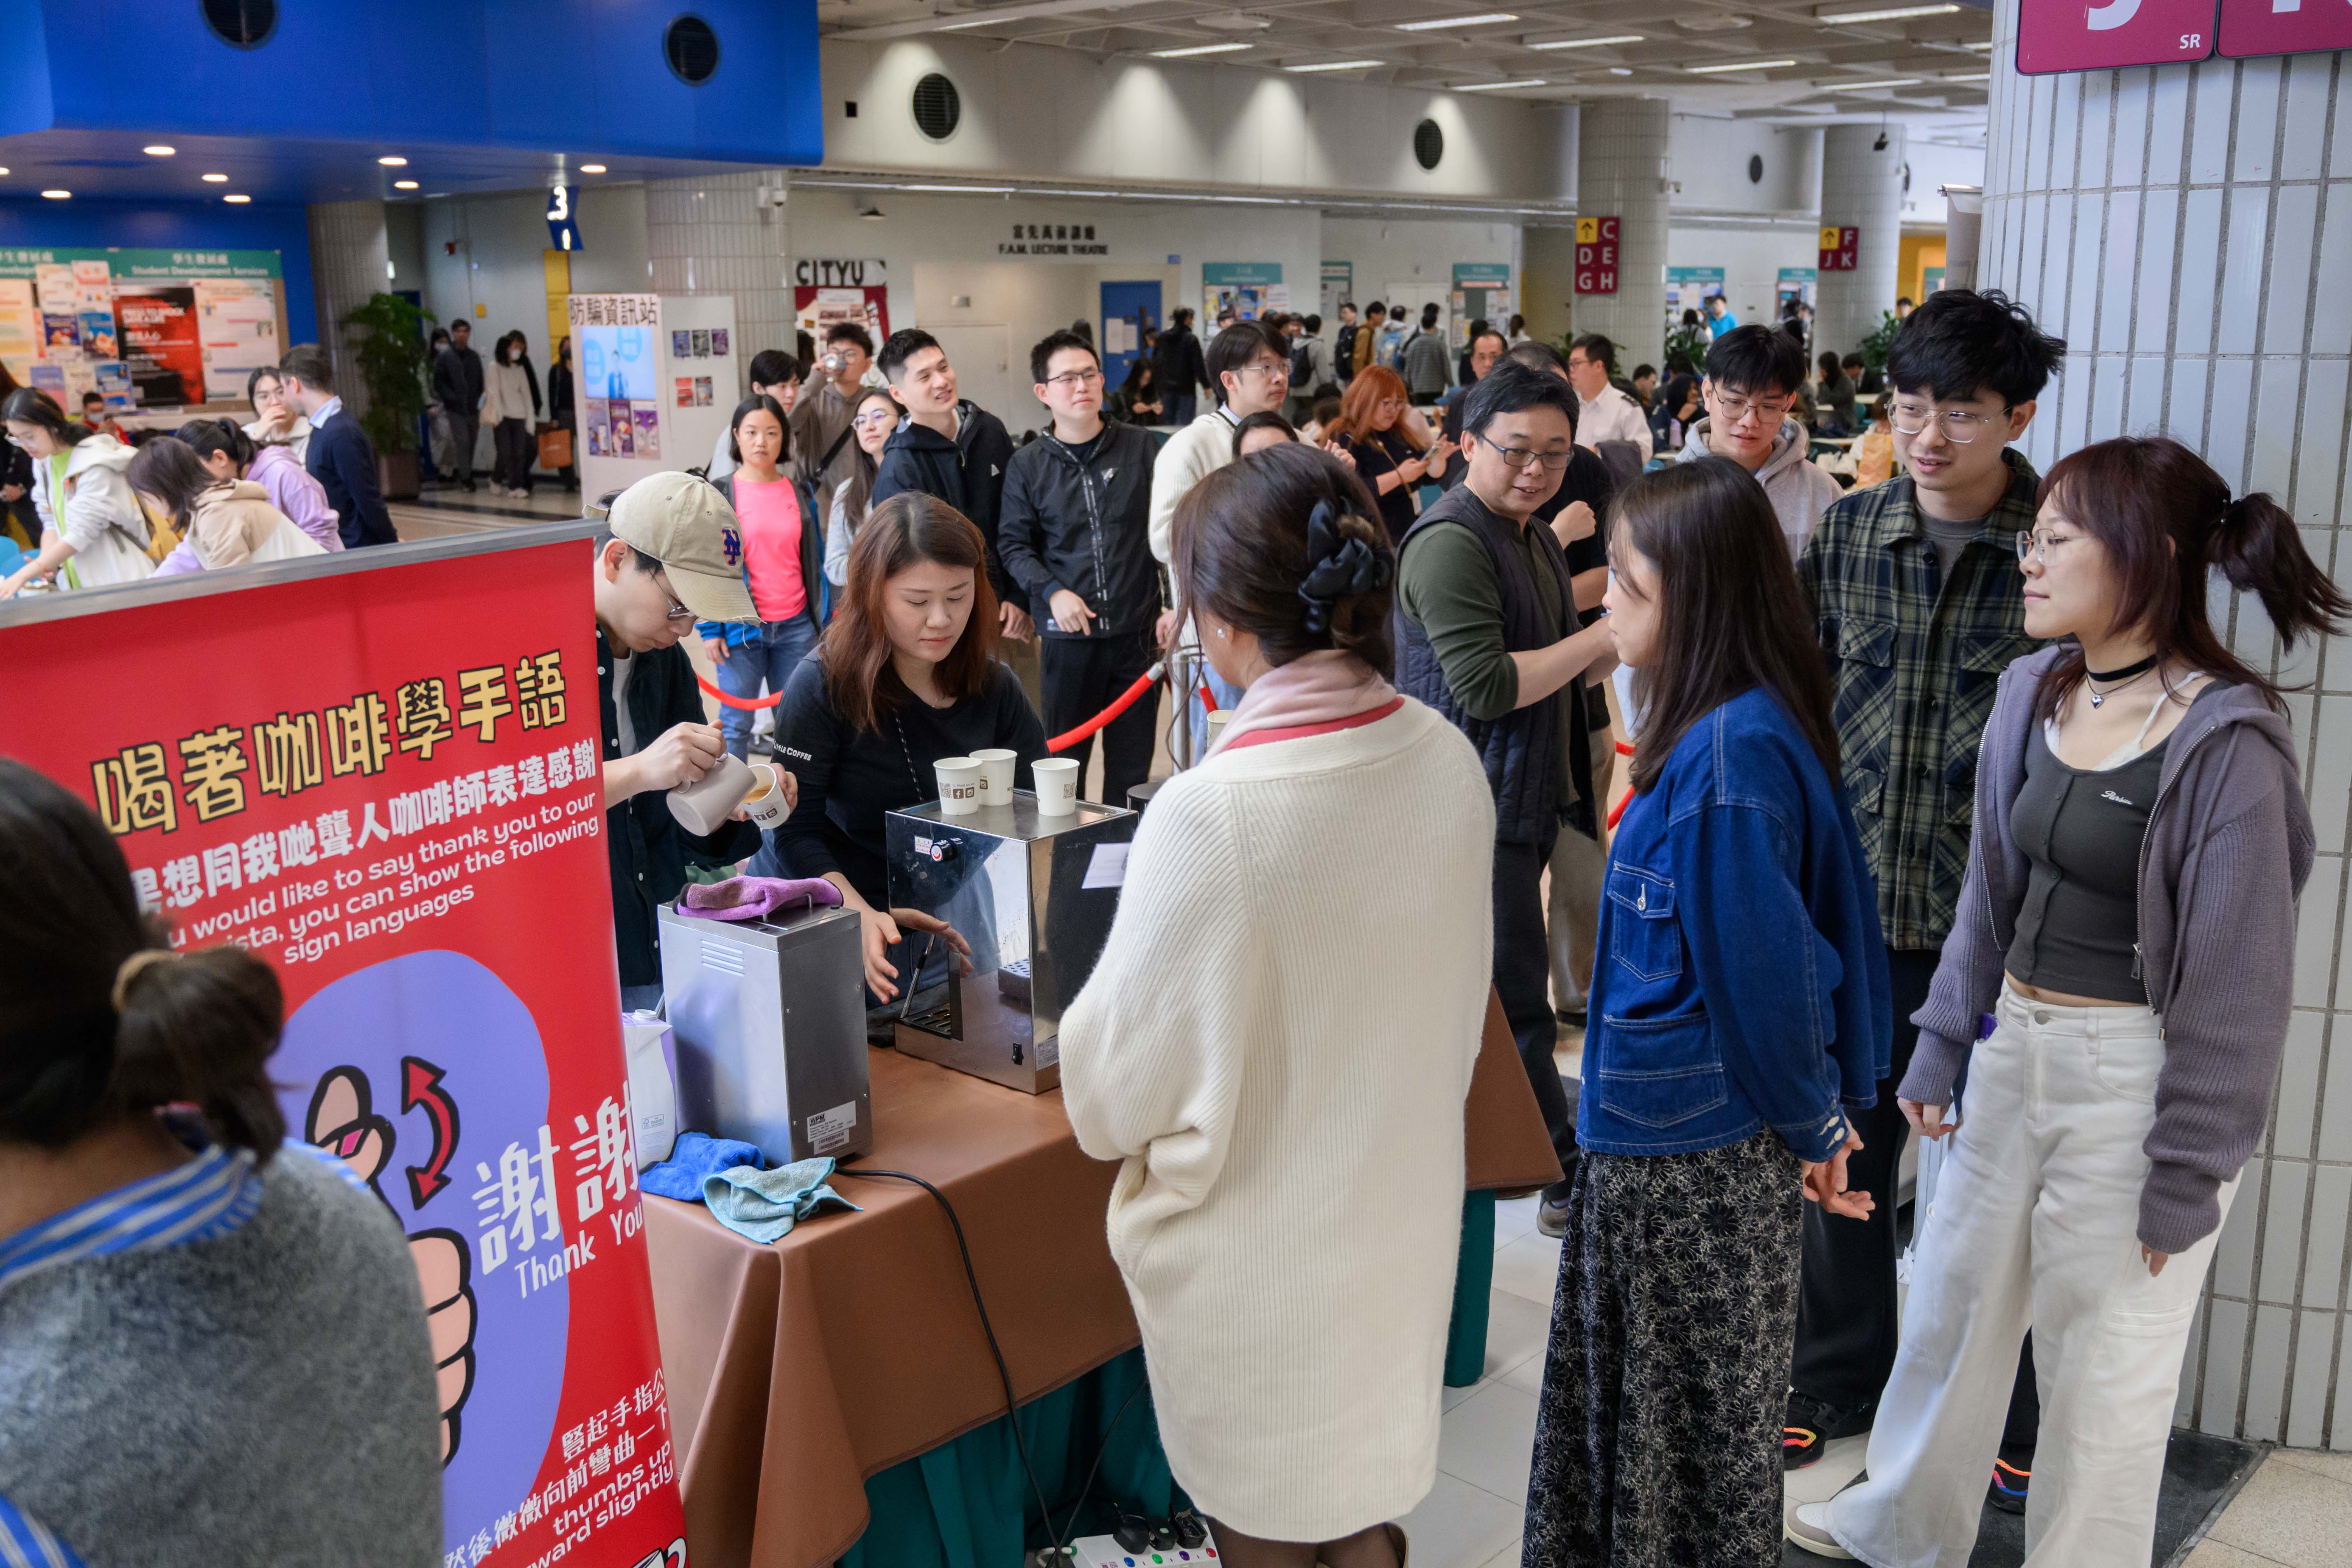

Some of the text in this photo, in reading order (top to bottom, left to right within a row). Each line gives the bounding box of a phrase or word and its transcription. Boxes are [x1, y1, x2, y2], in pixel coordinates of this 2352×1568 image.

[2180, 34, 2200, 50] SR
[1603, 221, 1615, 239] C
[1844, 230, 1853, 245] F
[1579, 247, 1613, 264] D E
[1841, 252, 1852, 268] K
[1579, 272, 1613, 290] G H
[569, 297, 657, 326] 防騙資訊站
[90, 649, 565, 835] 喝著咖啡學手語
[787, 747, 812, 761] COFFEE
[192, 892, 276, 940] would
[282, 880, 329, 909] like
[334, 868, 362, 890] to
[368, 852, 415, 880] say
[419, 825, 489, 863] thank
[494, 814, 537, 845] you
[540, 805, 562, 824] to
[565, 791, 596, 816] our
[289, 903, 340, 940] you
[346, 886, 394, 914] can
[399, 862, 460, 898] show
[464, 849, 506, 875] the
[509, 816, 599, 860] following
[284, 884, 475, 964] sign languages
[810, 1113, 825, 1124] WPM
[472, 1080, 638, 1275] 謝謝
[514, 1202, 643, 1299] Thank You
[561, 1367, 665, 1464] 豎起手指公
[553, 1440, 670, 1536] thumbs up
[596, 1458, 674, 1528] slightly
